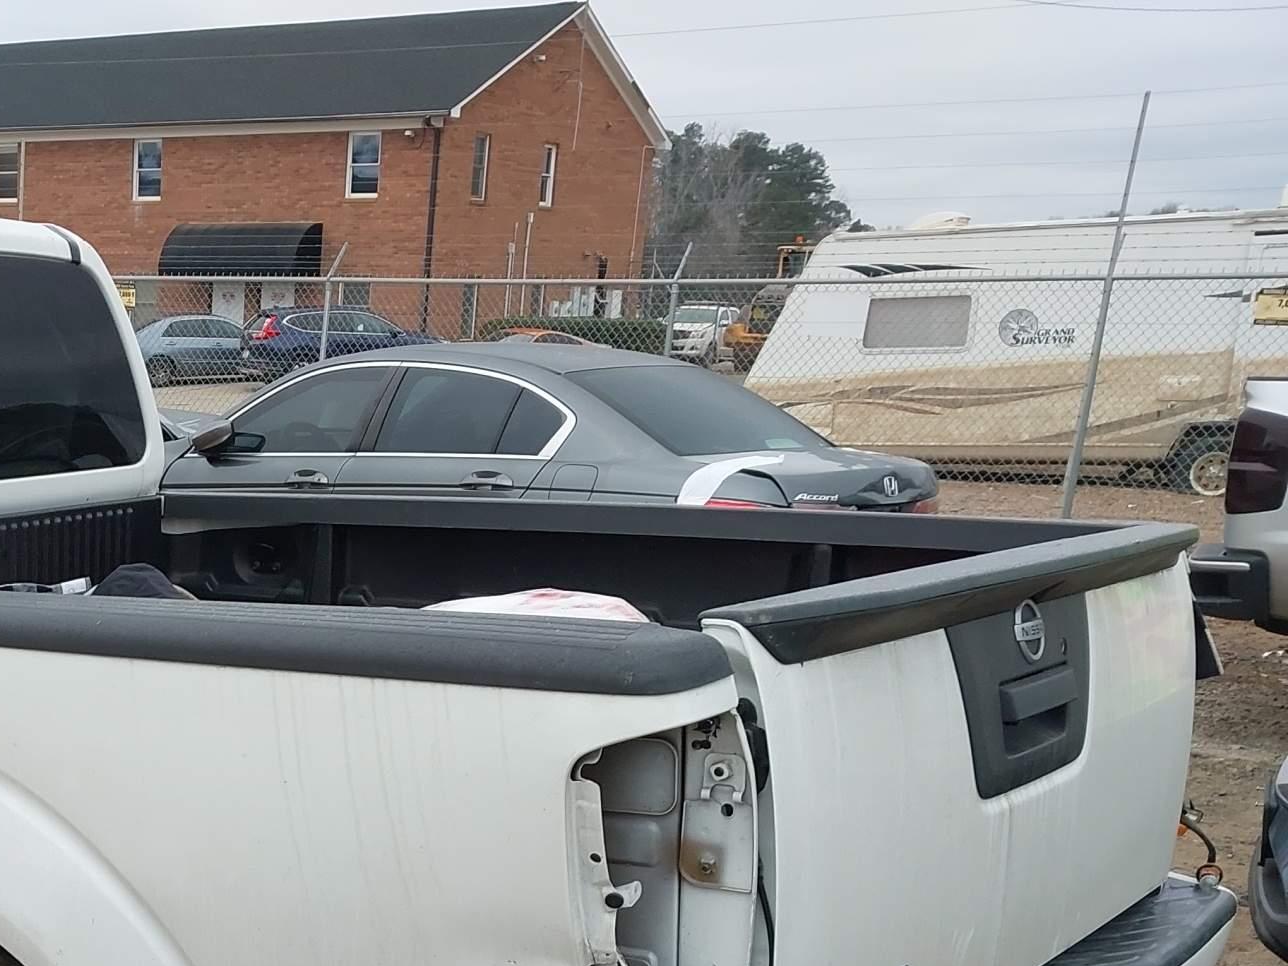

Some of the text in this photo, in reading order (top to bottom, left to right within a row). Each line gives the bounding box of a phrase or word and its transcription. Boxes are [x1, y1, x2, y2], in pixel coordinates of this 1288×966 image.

[1037, 327, 1075, 337] GRAND
[1011, 333, 1076, 345] SURVEYOR
[793, 493, 839, 502] Accord
